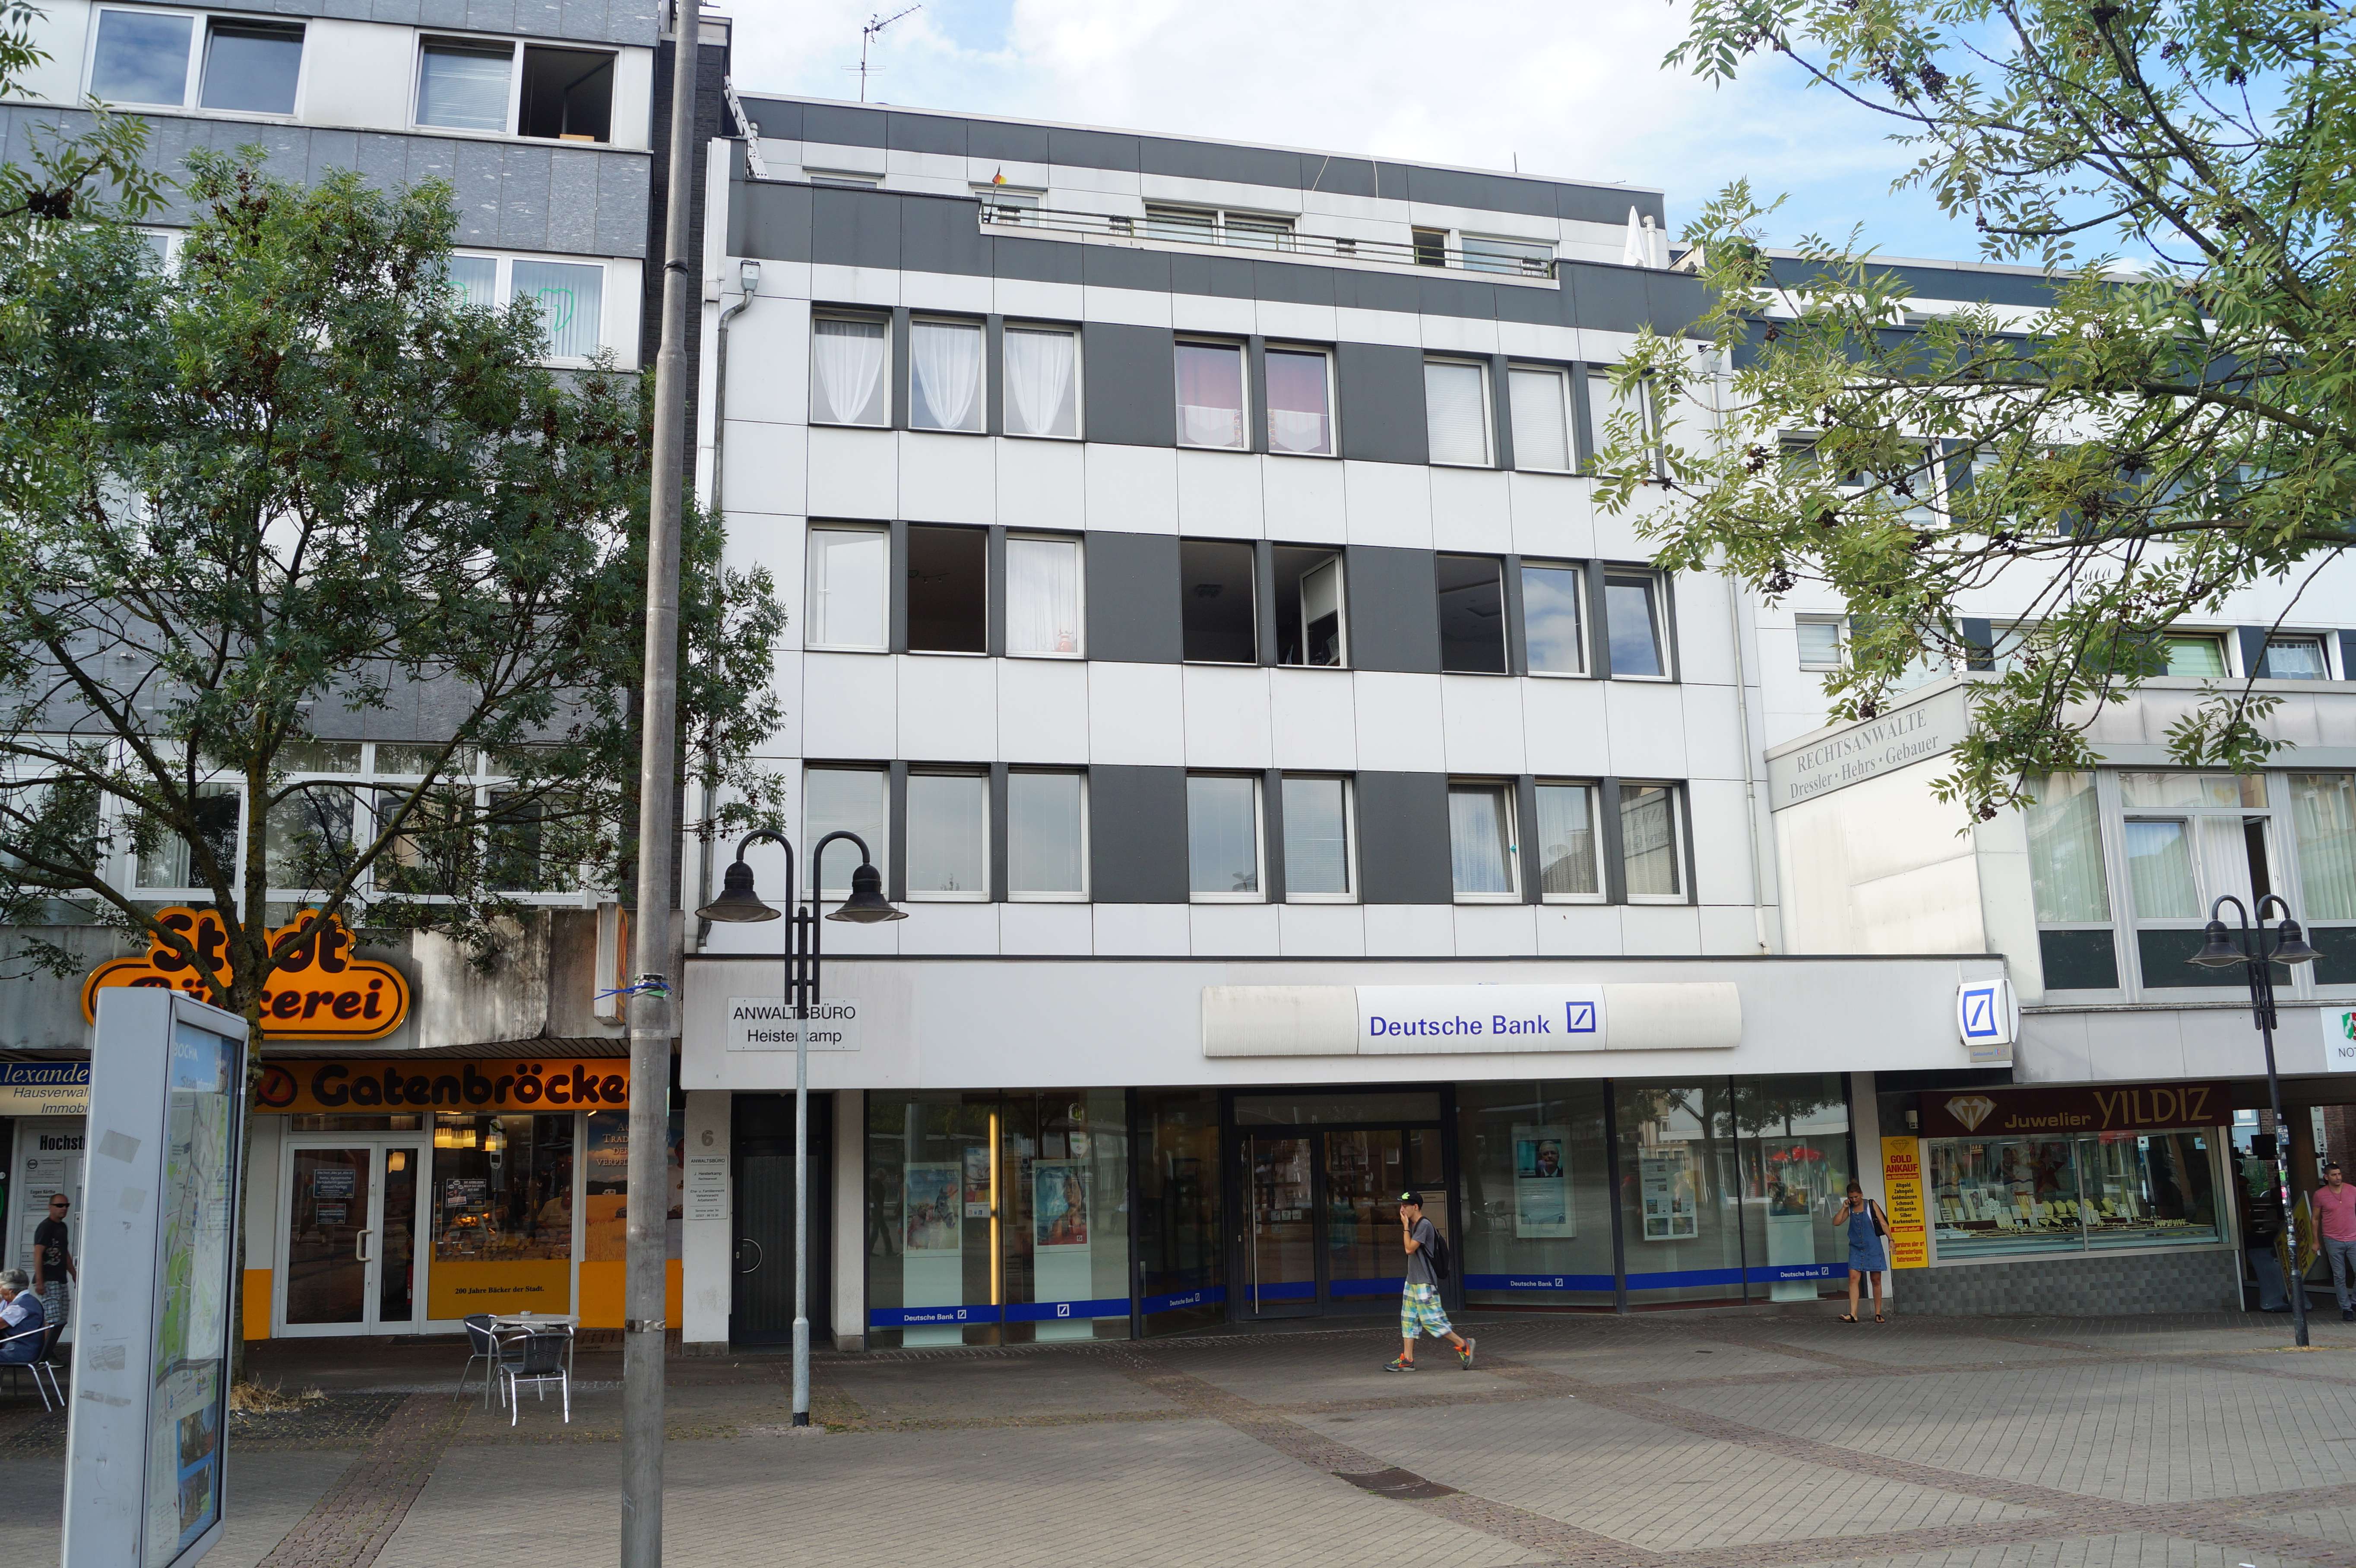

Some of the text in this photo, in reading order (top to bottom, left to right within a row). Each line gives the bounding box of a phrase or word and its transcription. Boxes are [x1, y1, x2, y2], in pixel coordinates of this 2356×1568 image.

[1796, 708, 1927, 773] RECHTSANWÄLTE
[1789, 735, 1939, 799] Dressler Hehrs Gebauer
[152, 914, 347, 973] Stdt
[733, 1003, 856, 1020] ANWALTBÜRO
[1369, 1013, 1551, 1037] Deutsche Bank
[747, 1029, 842, 1044] Heisteamp
[0, 1064, 89, 1083] lexande
[311, 1063, 630, 1106] Gatenbröcke
[2004, 1087, 2213, 1129] Juwelier YILDIZ
[702, 1130, 714, 1147] 6
[1886, 1163, 1918, 1173] ANKAUF
[1890, 1154, 1912, 1163] GOLD
[904, 1312, 954, 1321] Deutsche Bank
